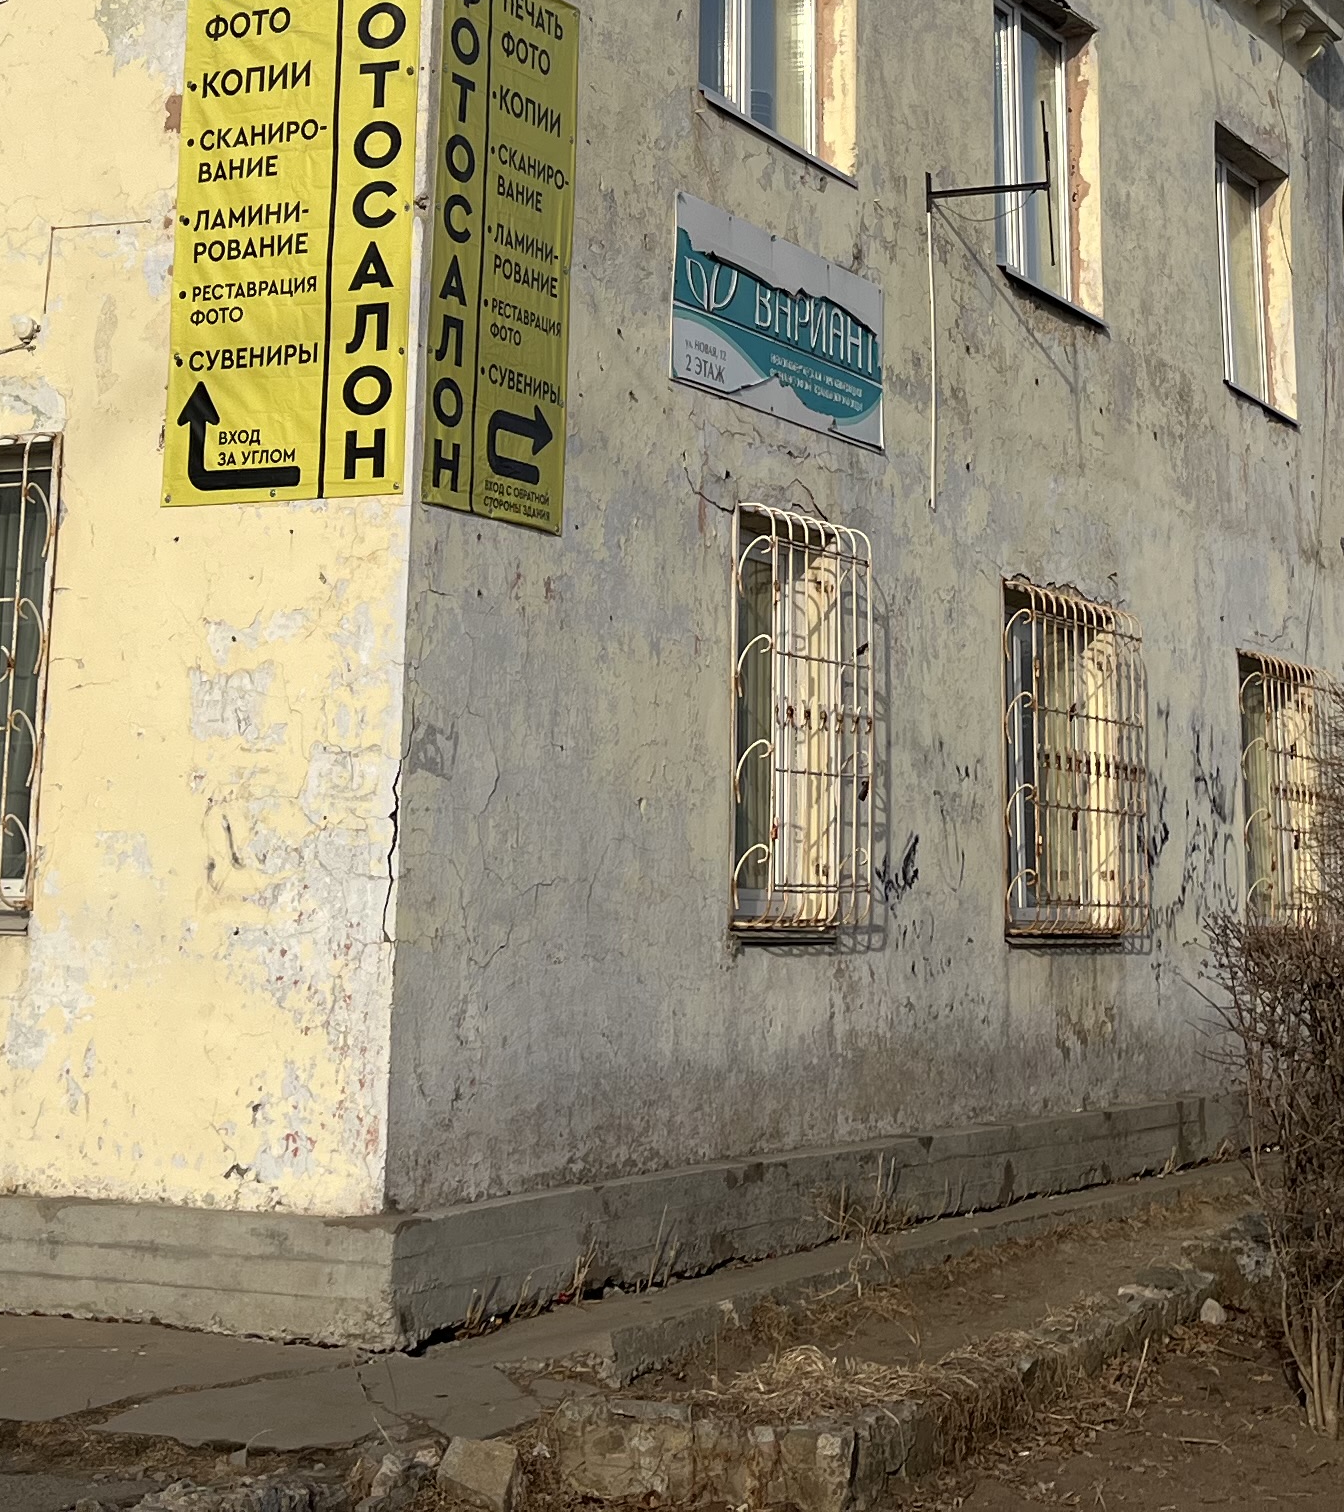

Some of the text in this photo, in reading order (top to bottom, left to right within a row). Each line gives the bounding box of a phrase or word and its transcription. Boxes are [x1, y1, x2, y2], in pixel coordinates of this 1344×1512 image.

[205, 6, 291, 42] ФОТО
[501, 30, 551, 76] ФОТО
[201, 59, 312, 99] КОПИИ
[499, 84, 562, 138] КОПИИ
[199, 118, 328, 151] СКАНИРО-
[197, 154, 279, 184] ВАНИЕ
[497, 143, 569, 190] СКАНИРО-
[496, 173, 543, 214] ВАНИЕ
[193, 200, 309, 232] ЛАМИНИ-
[193, 232, 309, 264] РОВАНИЕ
[493, 223, 559, 266] ЛАМИНИ-
[191, 275, 318, 302] РЕСТАВРАЦИЯ
[493, 253, 558, 299] РОВАНИЕ
[190, 306, 244, 326] ФОТО
[491, 297, 562, 338] РЕСТАВРАЦИЯ
[489, 321, 522, 346] ФОТО
[188, 342, 319, 372] СУВЕНИРЫ
[685, 353, 726, 385] 2 ЭТАЖ
[488, 363, 562, 407] СУВЕНИРЫ
[218, 429, 261, 447] ВХОД
[217, 448, 296, 467] ЗА УГЛОМ
[483, 495, 551, 521] СТОРОНЫ ЗДАНИЯ
[484, 479, 550, 506] ВХОД С ОБРАТНОЙ
